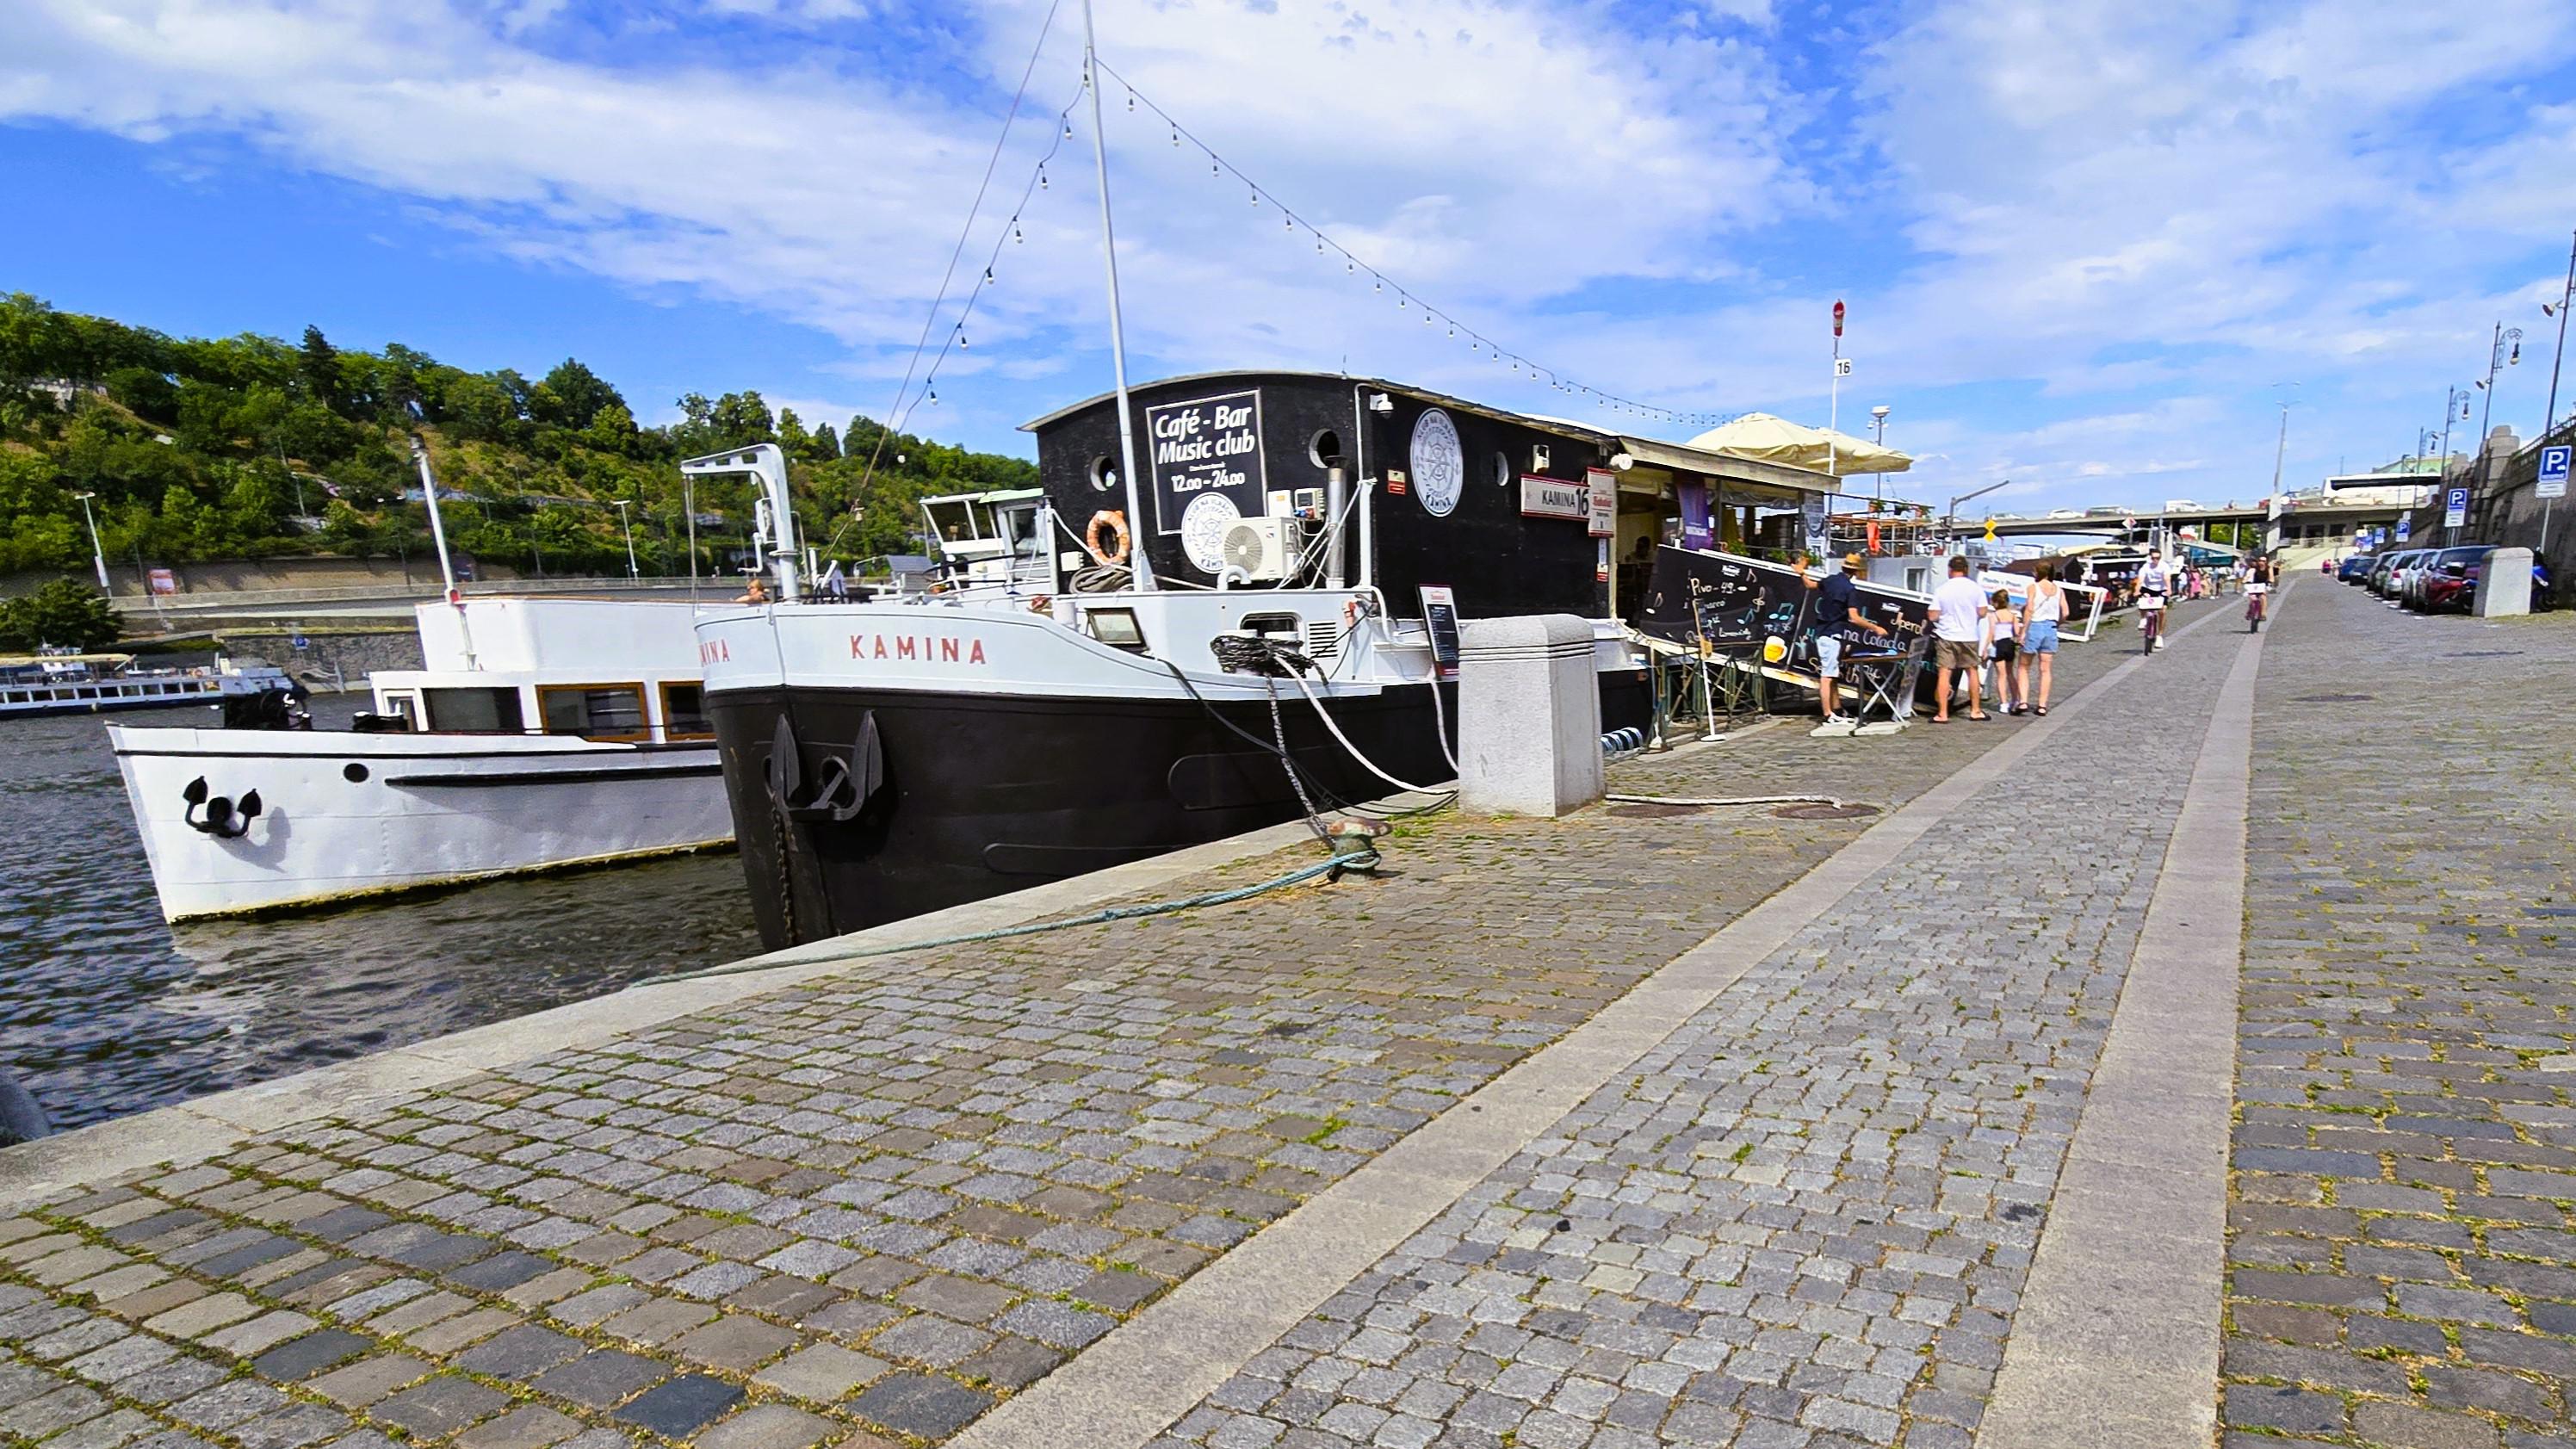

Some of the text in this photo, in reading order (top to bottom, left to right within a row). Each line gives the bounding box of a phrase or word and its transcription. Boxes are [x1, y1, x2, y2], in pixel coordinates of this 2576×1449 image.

[1836, 362, 1850, 375] 16
[1155, 408, 1200, 442] Café
[1214, 405, 1253, 430] Bar
[1157, 428, 1255, 465] Music club
[2546, 451, 2565, 472] P
[1542, 489, 1576, 508] KAMINA
[1576, 487, 1589, 516] 16
[2451, 492, 2463, 505] P
[850, 635, 986, 665] KAMINA
